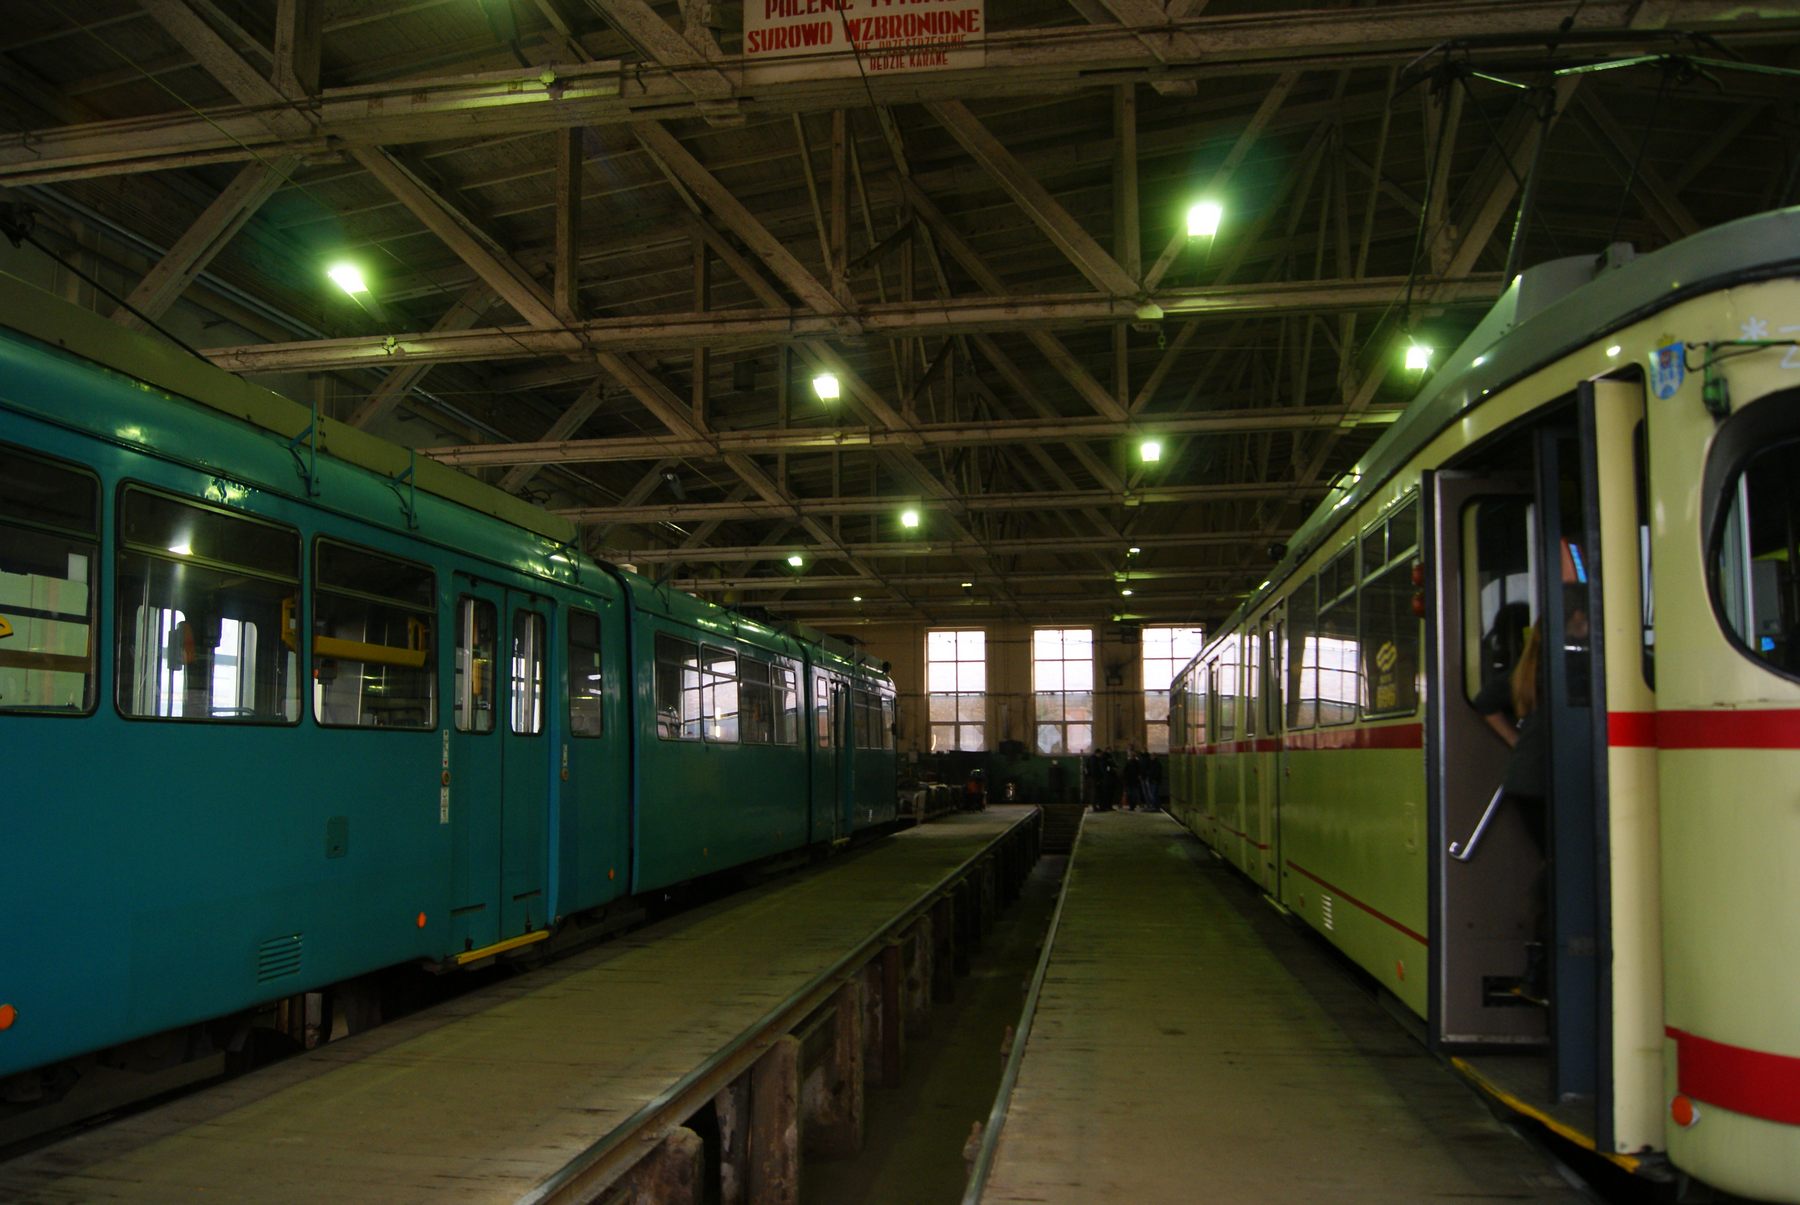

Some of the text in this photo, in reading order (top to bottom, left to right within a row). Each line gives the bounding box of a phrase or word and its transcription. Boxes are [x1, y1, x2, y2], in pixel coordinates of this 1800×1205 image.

[747, 9, 980, 53] SUROWO WZBRONIONE
[909, 50, 949, 68] KARANE
